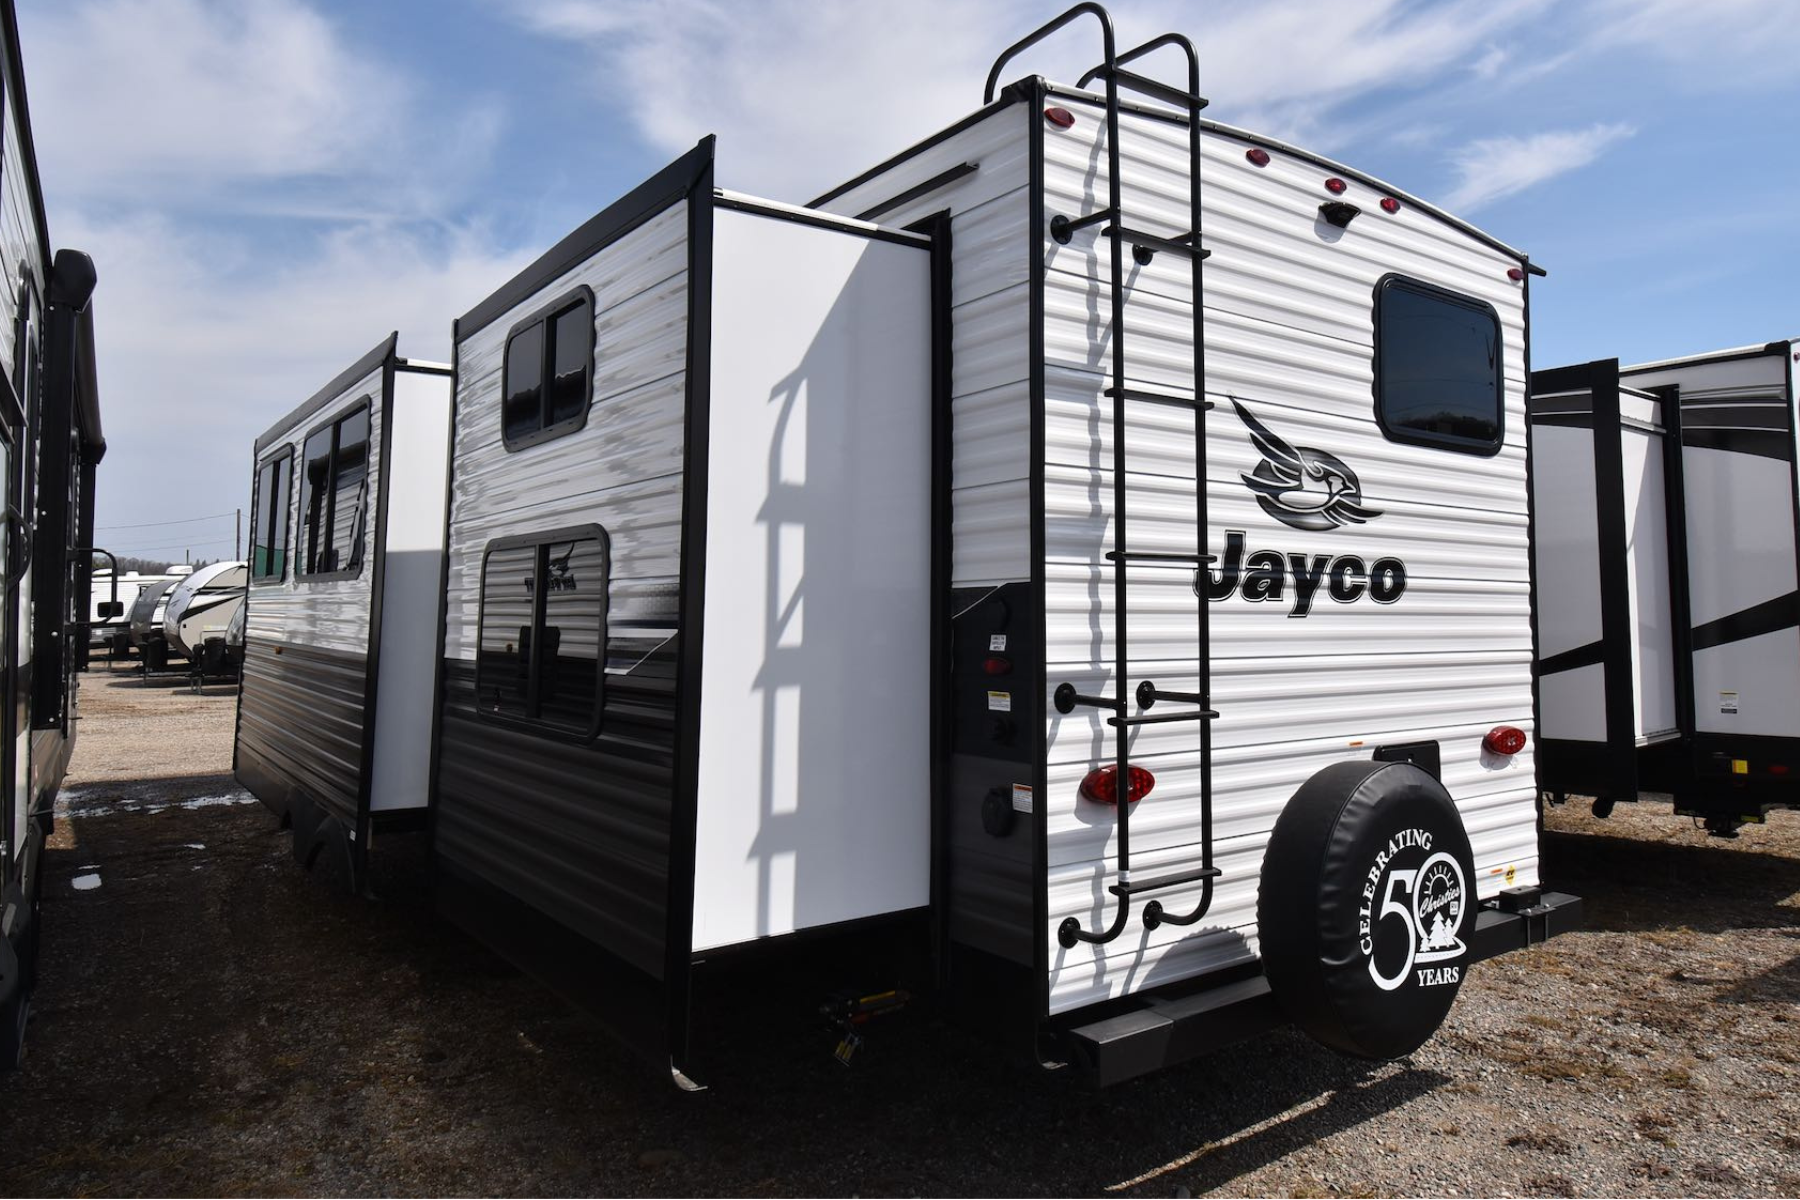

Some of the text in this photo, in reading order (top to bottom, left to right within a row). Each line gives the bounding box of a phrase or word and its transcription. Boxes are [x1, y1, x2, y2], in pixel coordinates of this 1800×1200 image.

[1193, 529, 1407, 618] Jayco
[1359, 829, 1433, 956] CELEBRATING
[1417, 966, 1460, 987] YEARS
